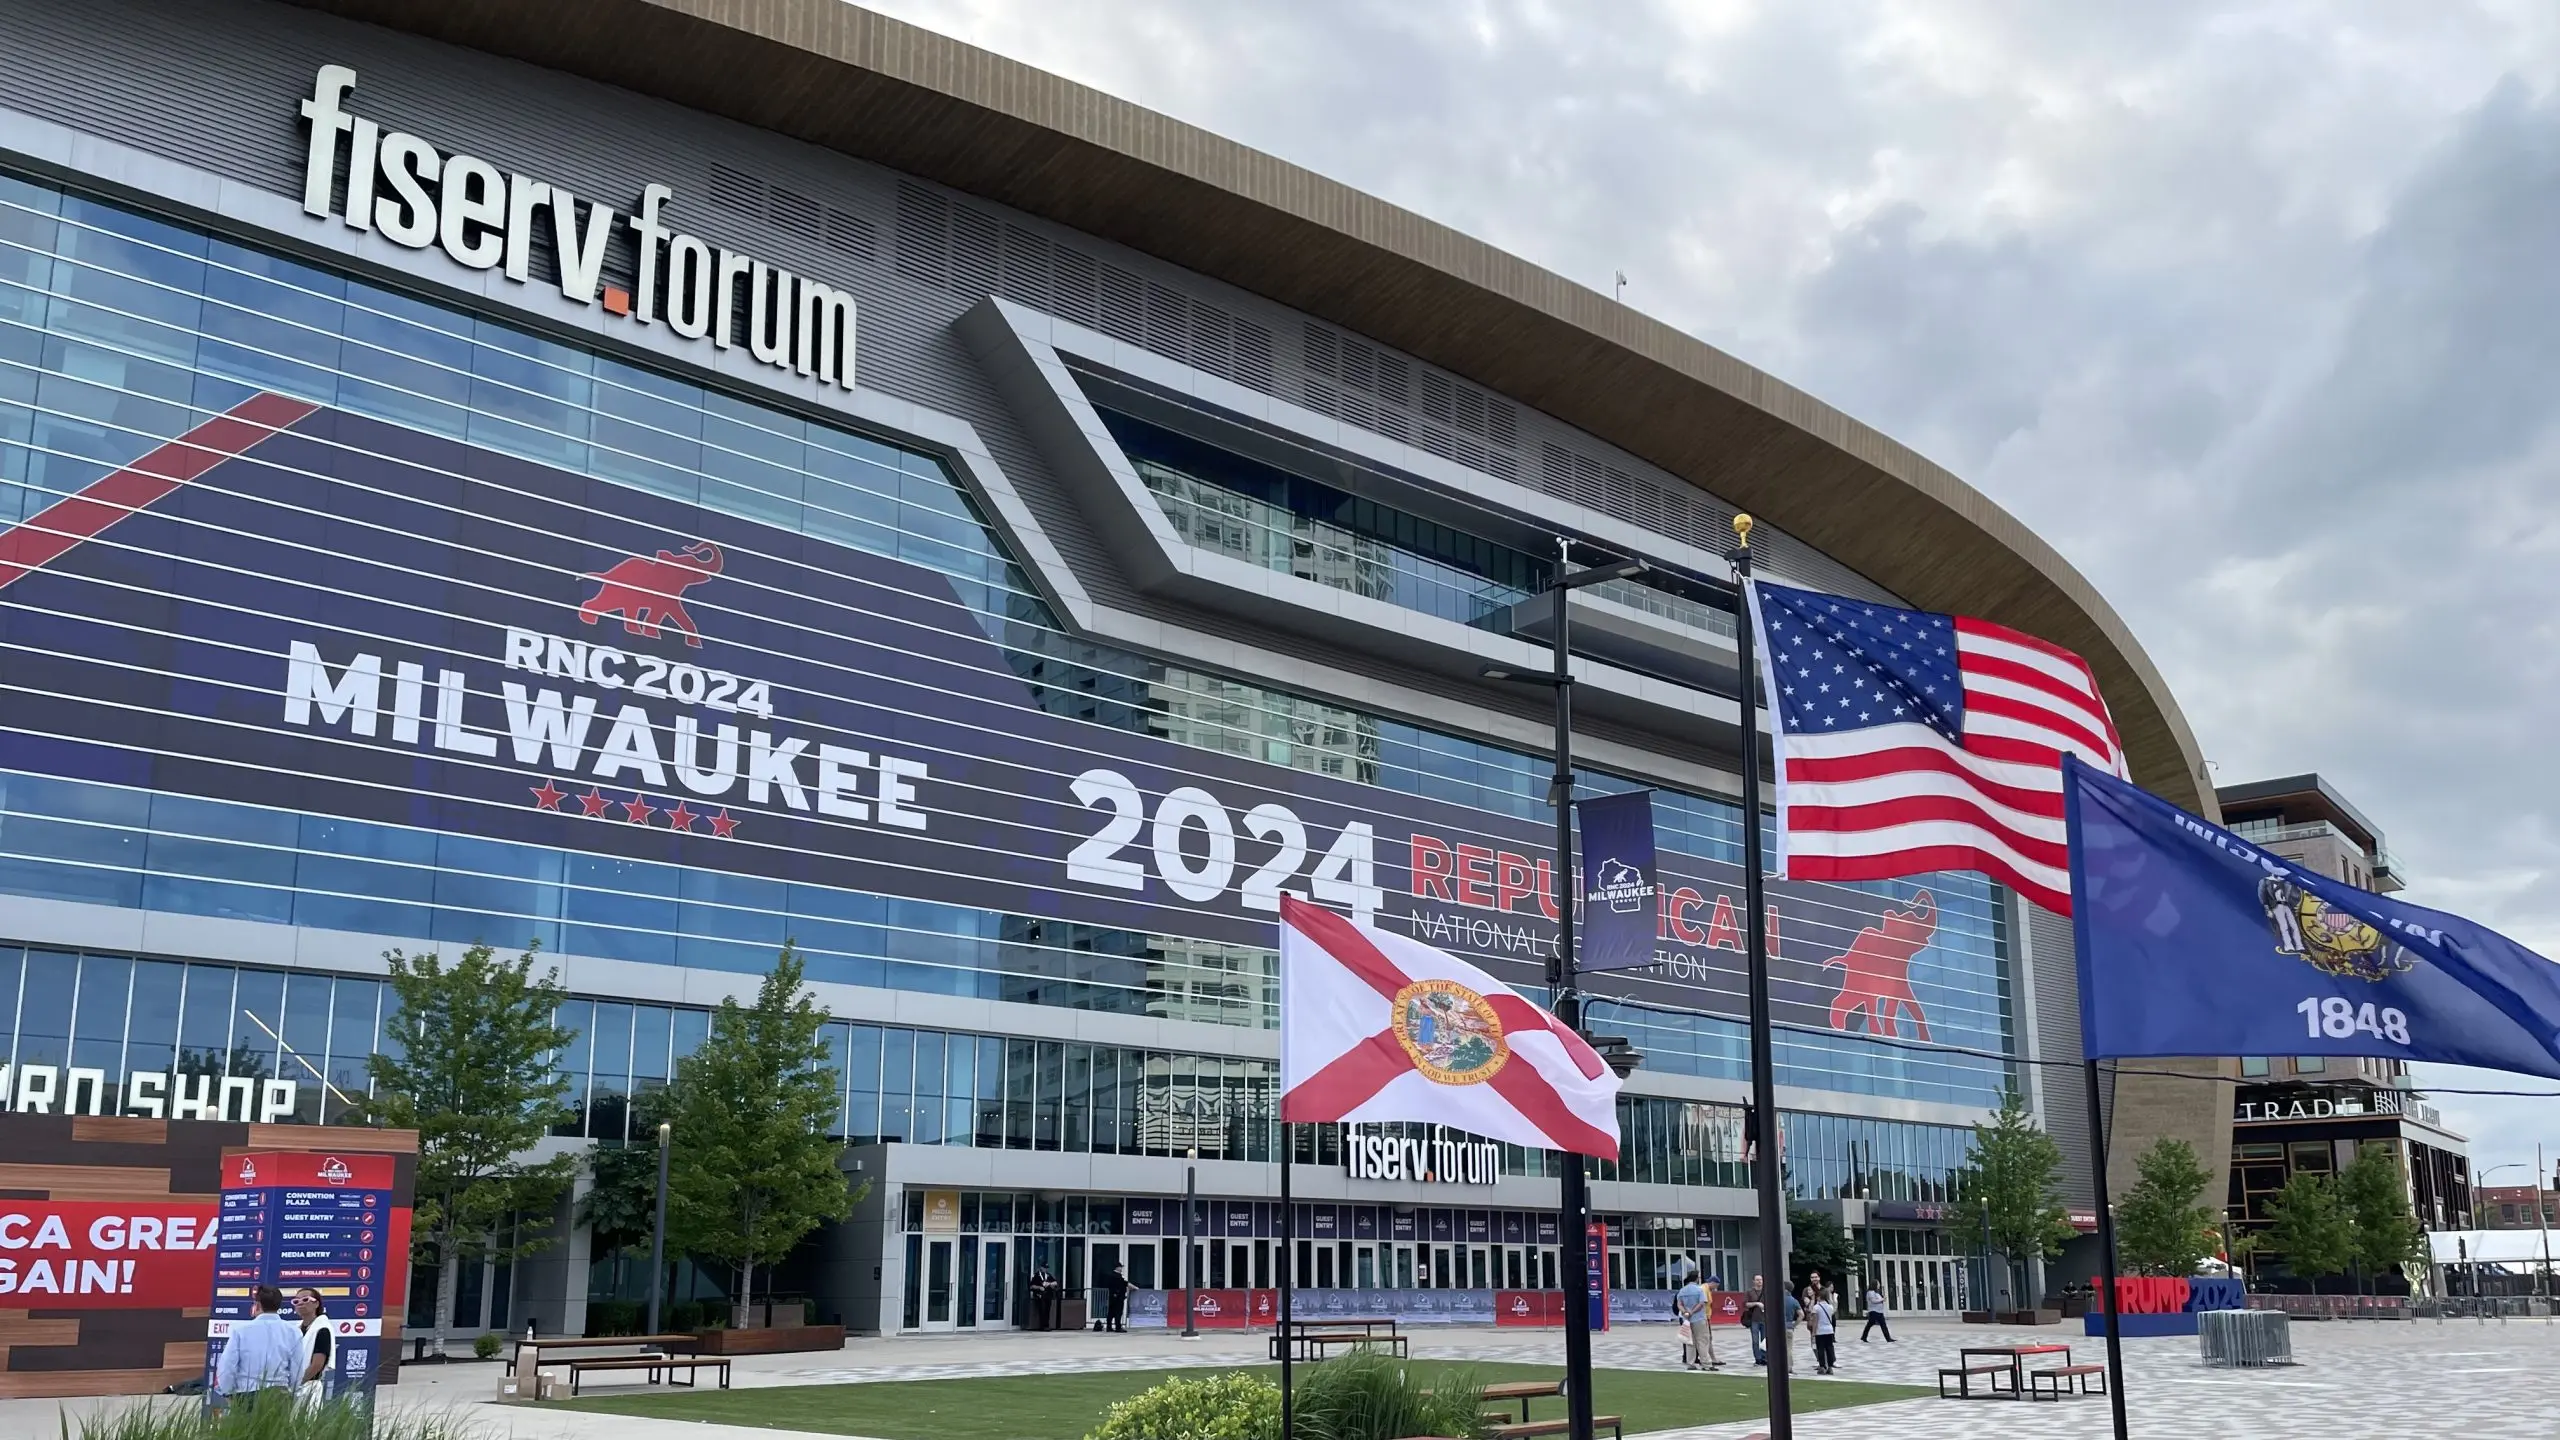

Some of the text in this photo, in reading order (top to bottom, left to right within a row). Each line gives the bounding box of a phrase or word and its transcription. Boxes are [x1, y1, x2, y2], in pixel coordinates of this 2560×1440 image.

[504, 625, 774, 720] RNC 2024
[283, 640, 928, 831] MILWAUKEE
[1066, 768, 1384, 928] 2024
[1588, 885, 1655, 902] MILWAUKEE
[1620, 881, 1635, 889] 2024
[1412, 908, 1546, 957] NATIONAL
[2297, 997, 2411, 1045] 1848
[2239, 1097, 2358, 1122] TRADE
[286, 1192, 335, 1200] CONVENTION
[88, 1215, 219, 1250] GREA
[213, 1323, 230, 1334] EXIT
